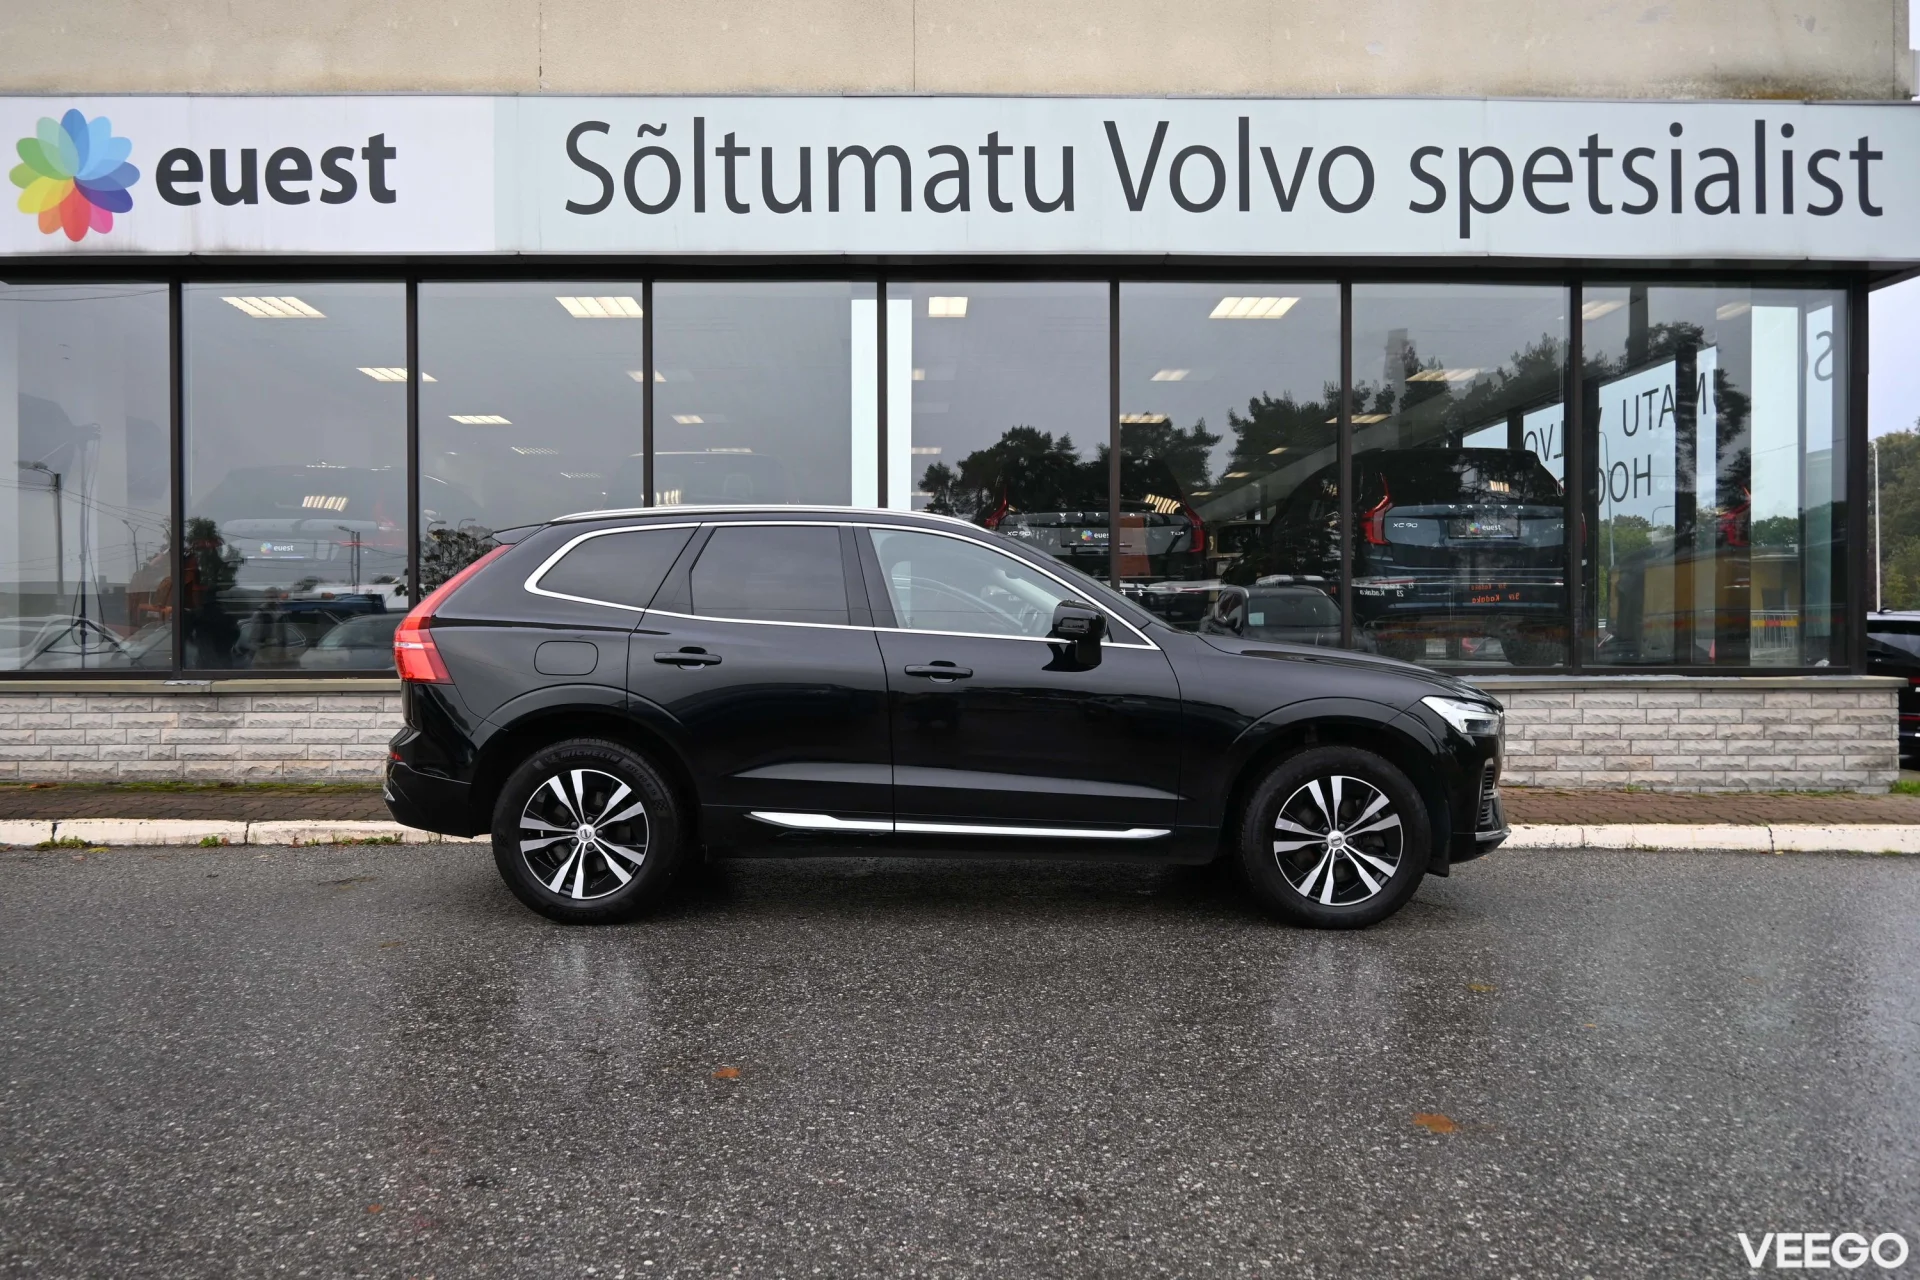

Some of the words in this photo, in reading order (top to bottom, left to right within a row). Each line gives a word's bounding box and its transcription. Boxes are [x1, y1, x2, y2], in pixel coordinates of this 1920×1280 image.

[156, 133, 396, 206] euest
[566, 117, 1075, 215] Sõltumatu
[1104, 117, 1374, 213] Volvo
[1409, 120, 1883, 238] spetsialist
[273, 544, 294, 552] euest
[560, 749, 620, 765] MICHELIN
